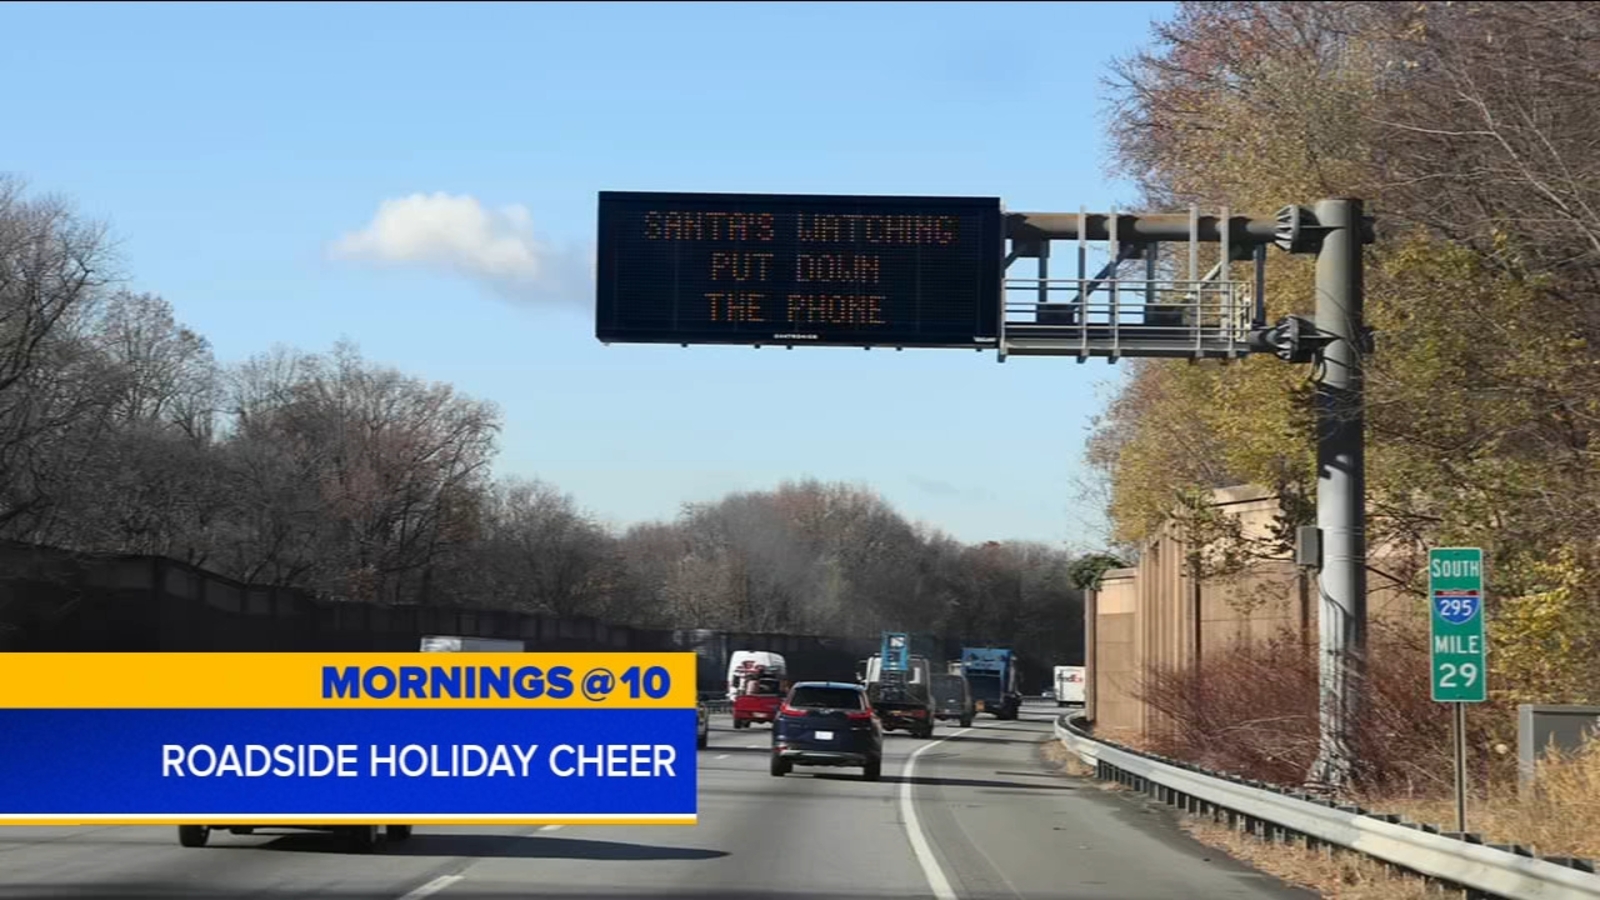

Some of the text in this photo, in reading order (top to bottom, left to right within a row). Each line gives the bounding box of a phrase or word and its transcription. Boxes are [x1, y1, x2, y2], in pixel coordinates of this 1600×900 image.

[644, 211, 955, 244] SANTA'S WATCHING
[712, 253, 879, 283] PUT DOWN
[704, 293, 886, 324] THE PHONE
[1432, 559, 1480, 578] SOUTH
[1440, 599, 1473, 616] 295
[1435, 635, 1480, 654] MILE
[1439, 662, 1478, 688] 29
